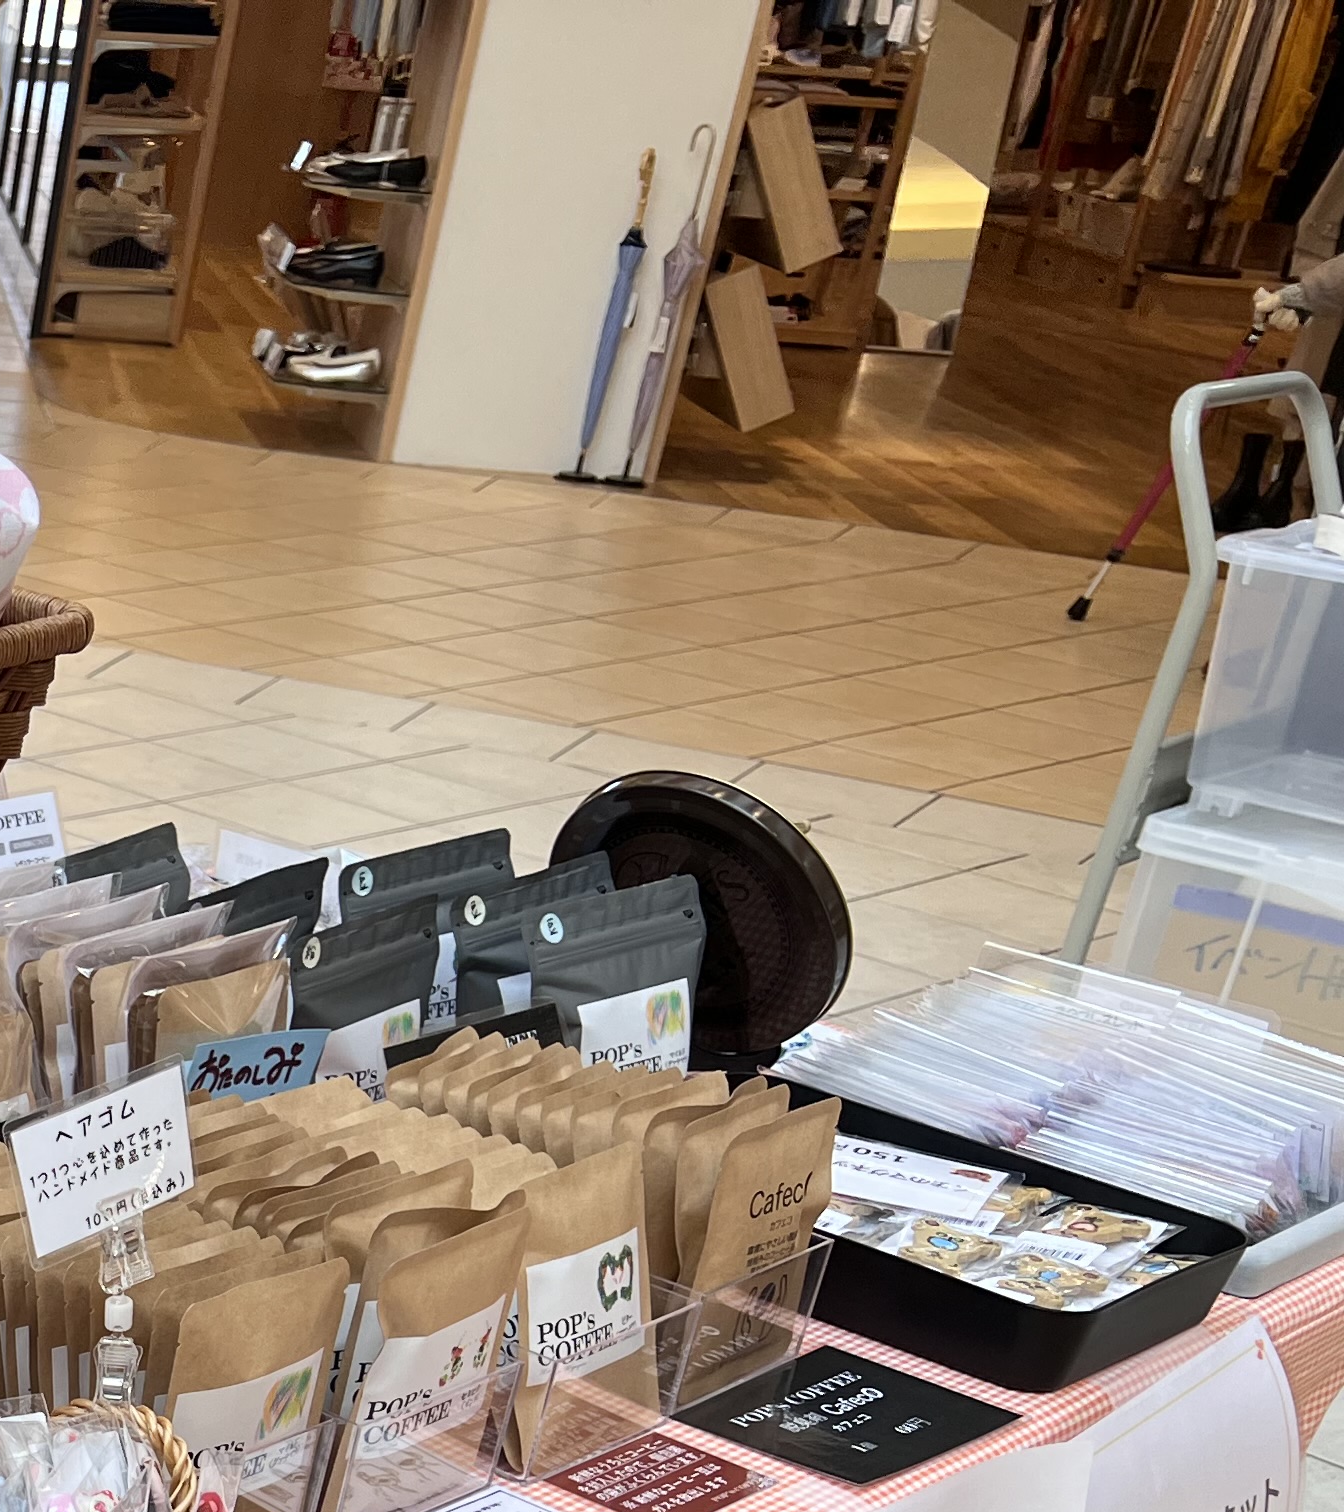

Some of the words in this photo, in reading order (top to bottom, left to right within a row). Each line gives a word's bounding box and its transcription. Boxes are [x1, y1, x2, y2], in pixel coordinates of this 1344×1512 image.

[190, 1042, 305, 1095] おたのしみ
[56, 1098, 136, 1142] ヘアゴム
[29, 1118, 174, 1189] 1つ1つ心を込めて作った
[38, 1139, 172, 1203] ハンドメイド商品です。
[538, 1322, 614, 1368] COFFEE
[784, 1369, 863, 1406] COFFEE
[363, 1399, 454, 1446] COFFEE
[832, 1413, 873, 1432] カフェコ
